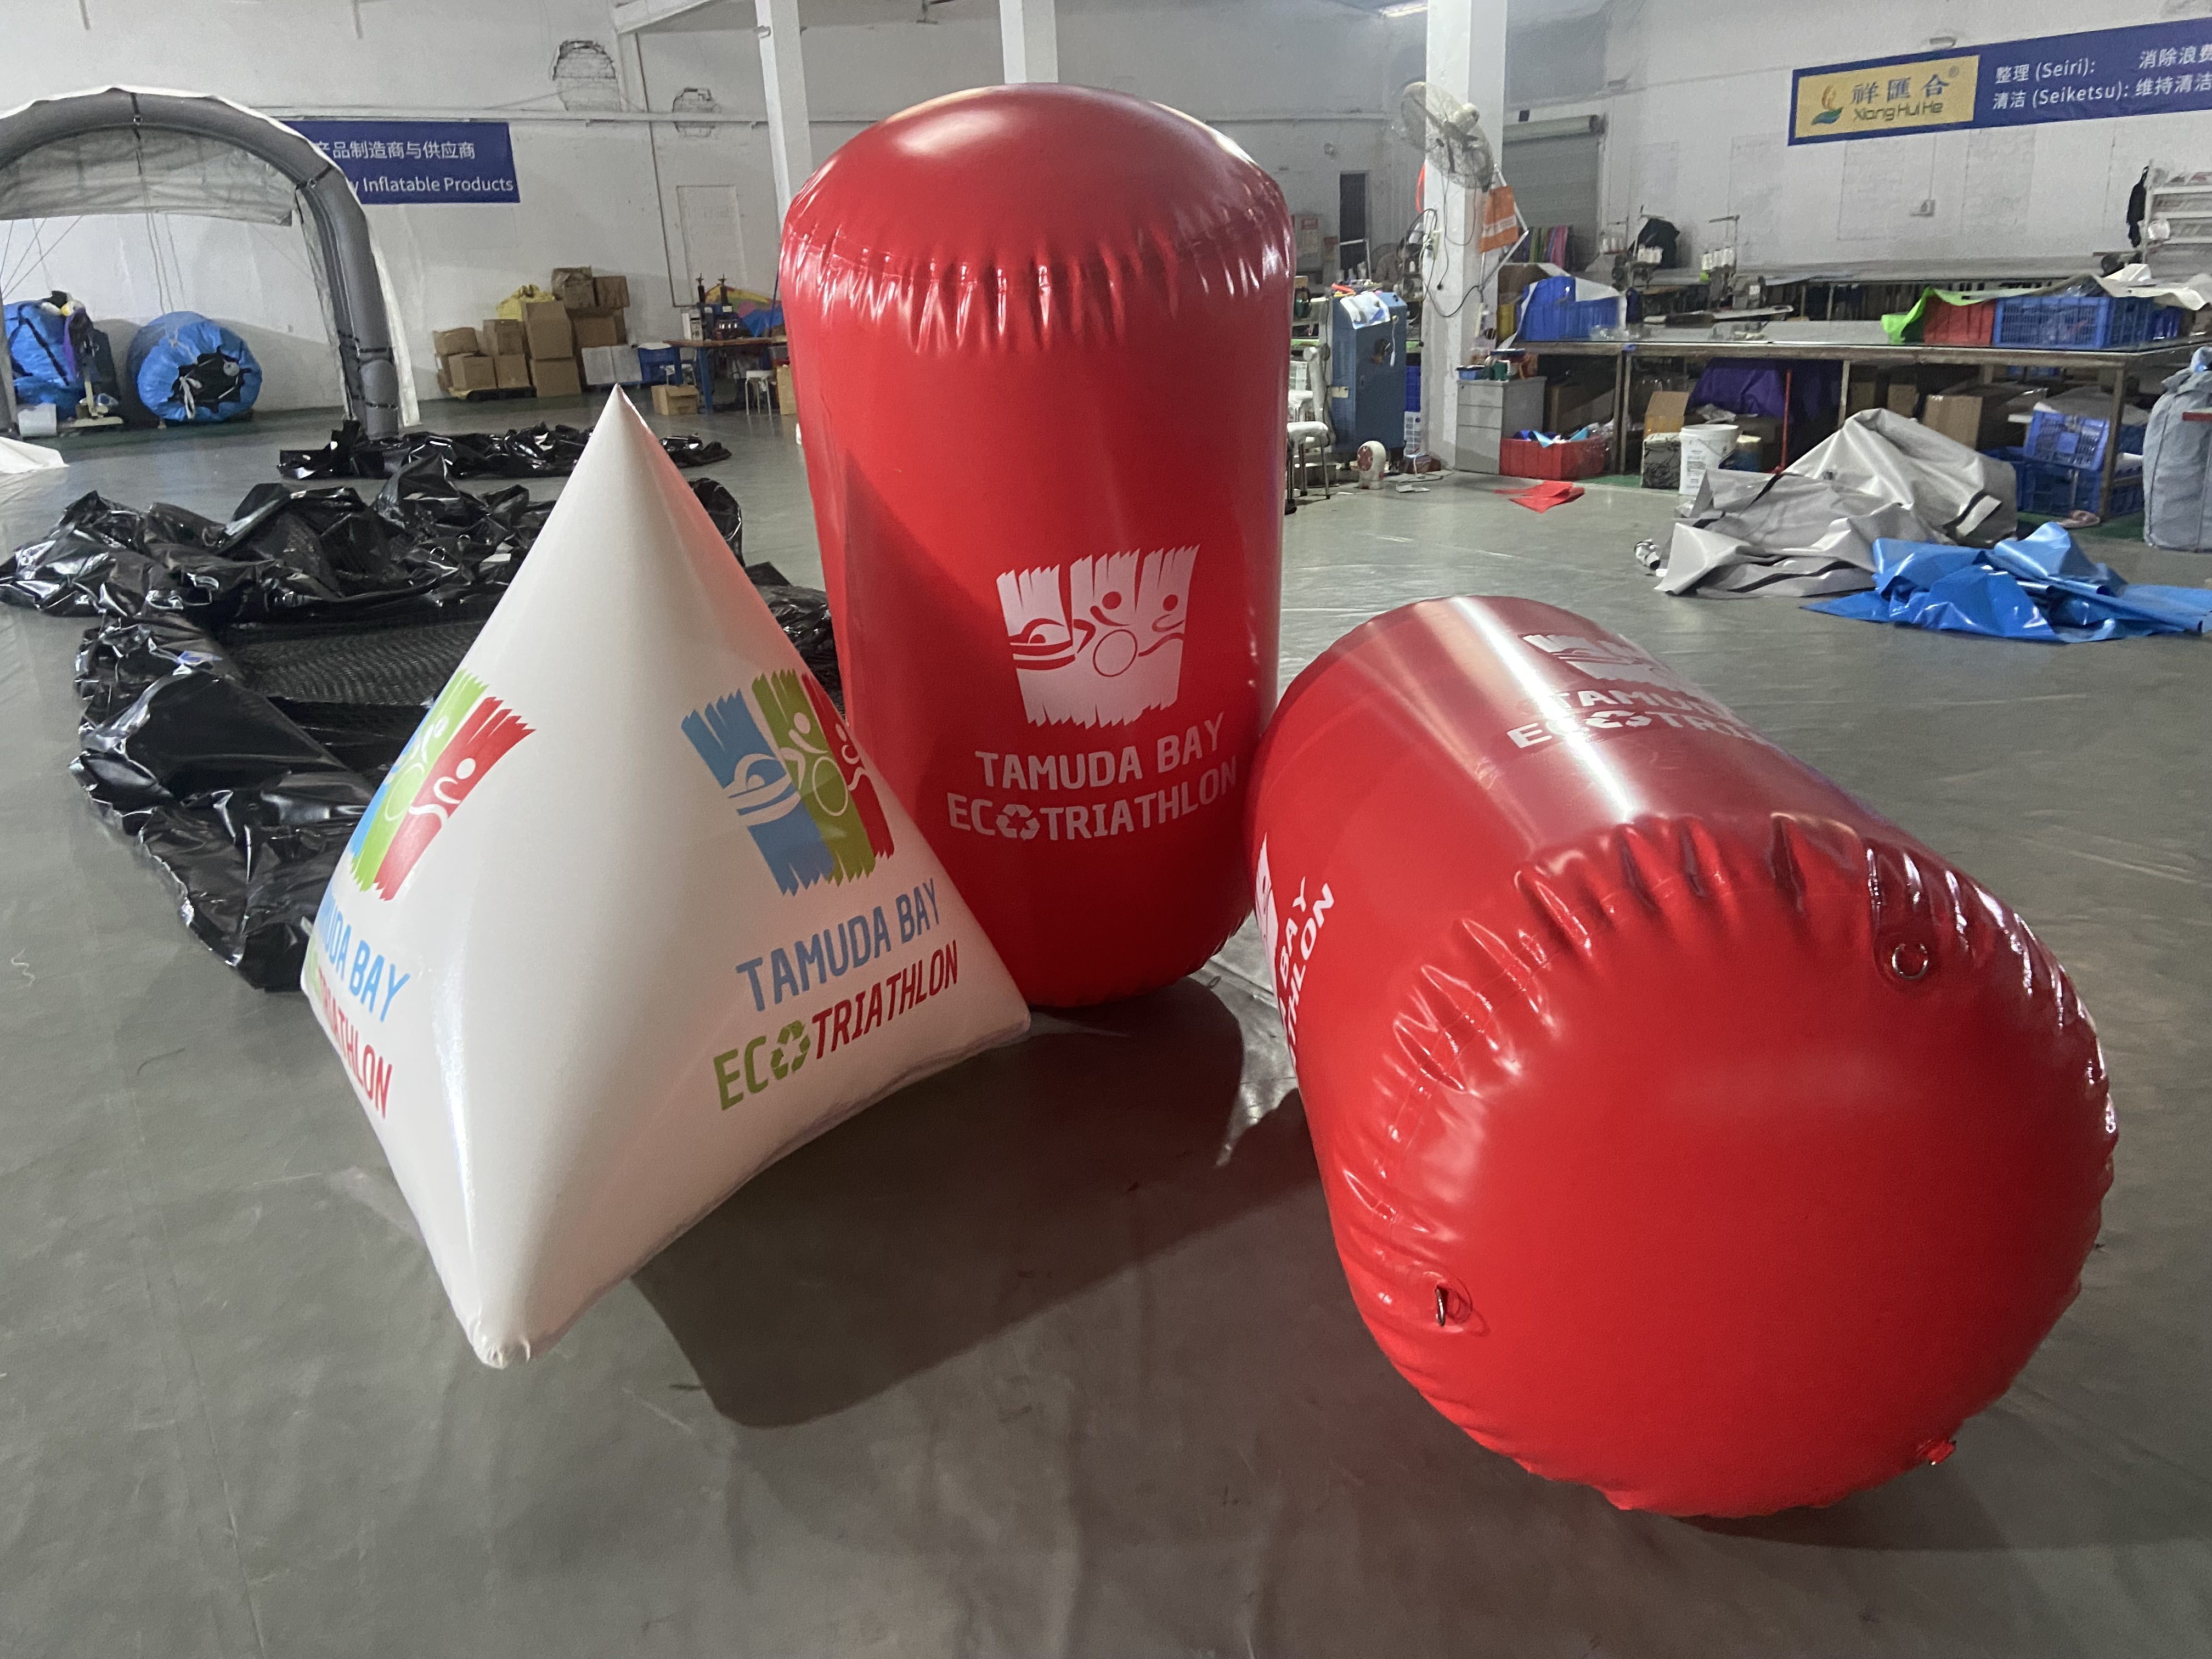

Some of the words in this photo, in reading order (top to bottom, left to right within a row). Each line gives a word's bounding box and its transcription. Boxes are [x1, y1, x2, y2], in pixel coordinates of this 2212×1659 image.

[1992, 89, 2026, 110] 清洁
[2032, 81, 2129, 108] (Seiketsu):
[1994, 64, 2029, 84] 整理
[2036, 58, 2096, 82] (Seiri):
[363, 176, 440, 193] Inflatable
[444, 177, 514, 193] Products
[975, 746, 1143, 791] TAMUDA
[1156, 712, 1224, 774] BAY
[736, 906, 891, 1012] TAMUDA
[895, 878, 939, 944] BAY
[1279, 876, 1306, 989] BAY
[349, 940, 410, 1023] BAY
